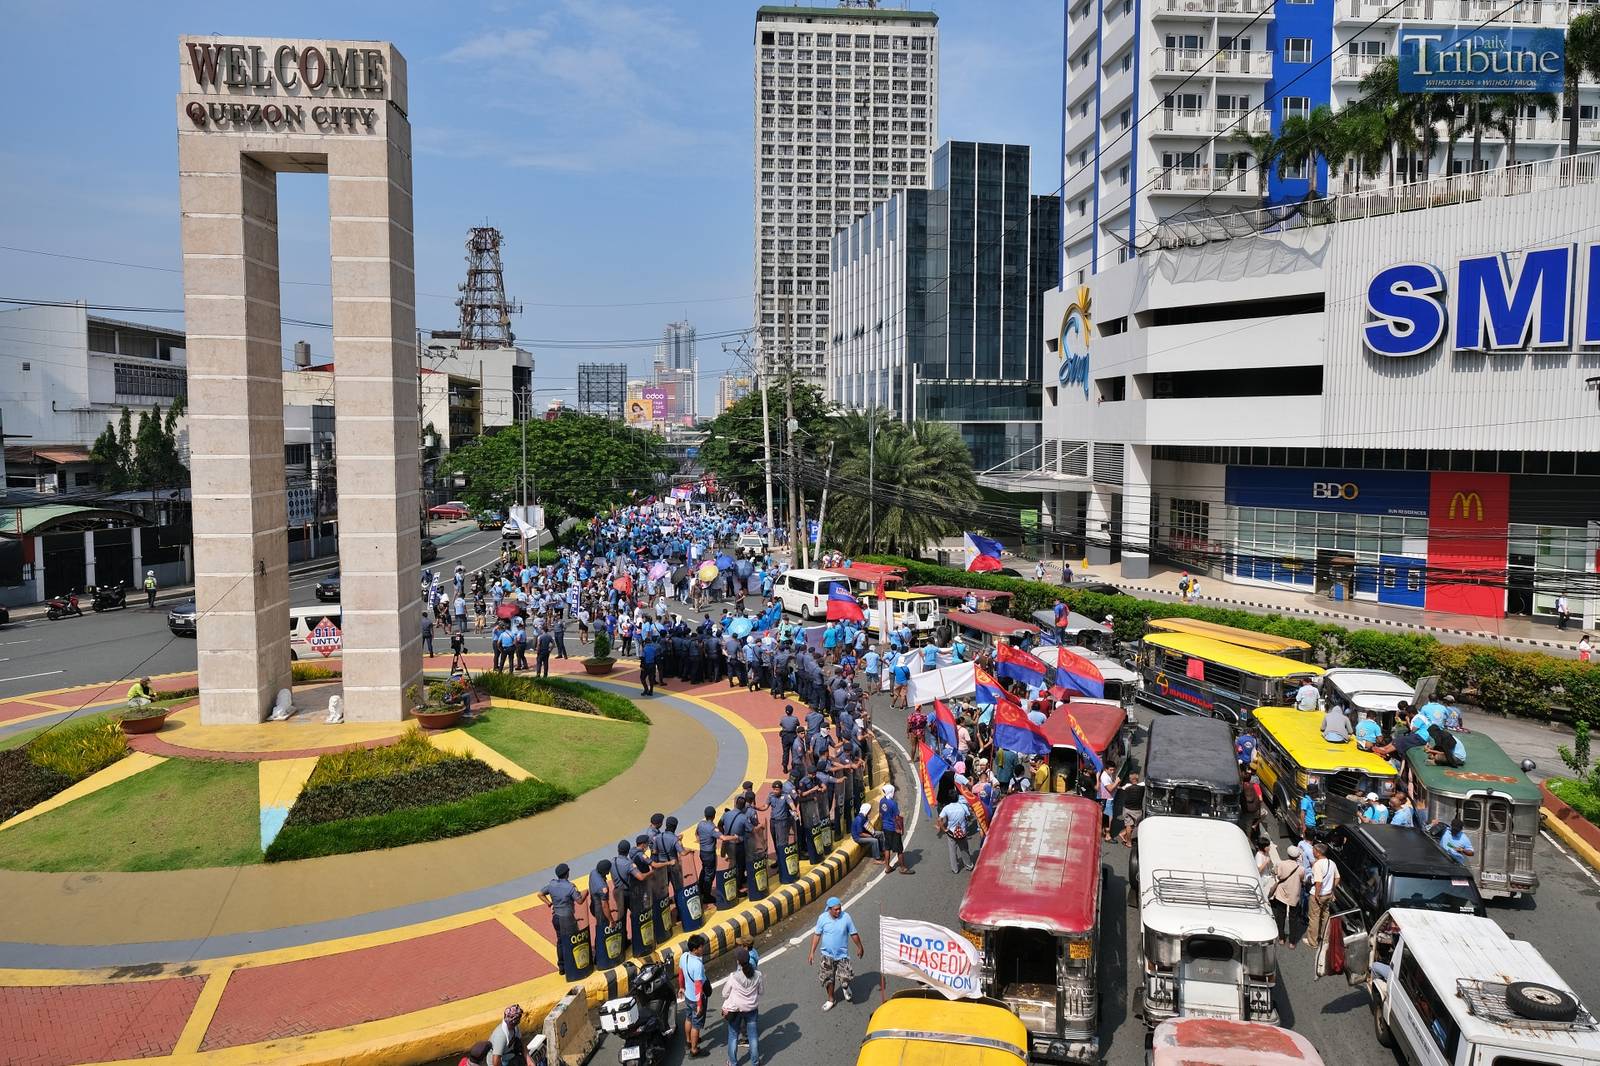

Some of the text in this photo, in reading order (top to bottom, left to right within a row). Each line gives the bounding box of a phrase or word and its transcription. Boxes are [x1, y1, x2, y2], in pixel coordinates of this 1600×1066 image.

[185, 42, 384, 91] WELCOME
[185, 101, 375, 128] QUEZON CITY
[1361, 242, 1600, 357] SM
[646, 392, 664, 400] odoo
[1313, 482, 1359, 500] BDO
[312, 637, 340, 646] UNTV
[314, 627, 337, 638] 911
[900, 933, 923, 948] NO
[925, 938, 945, 952] TO
